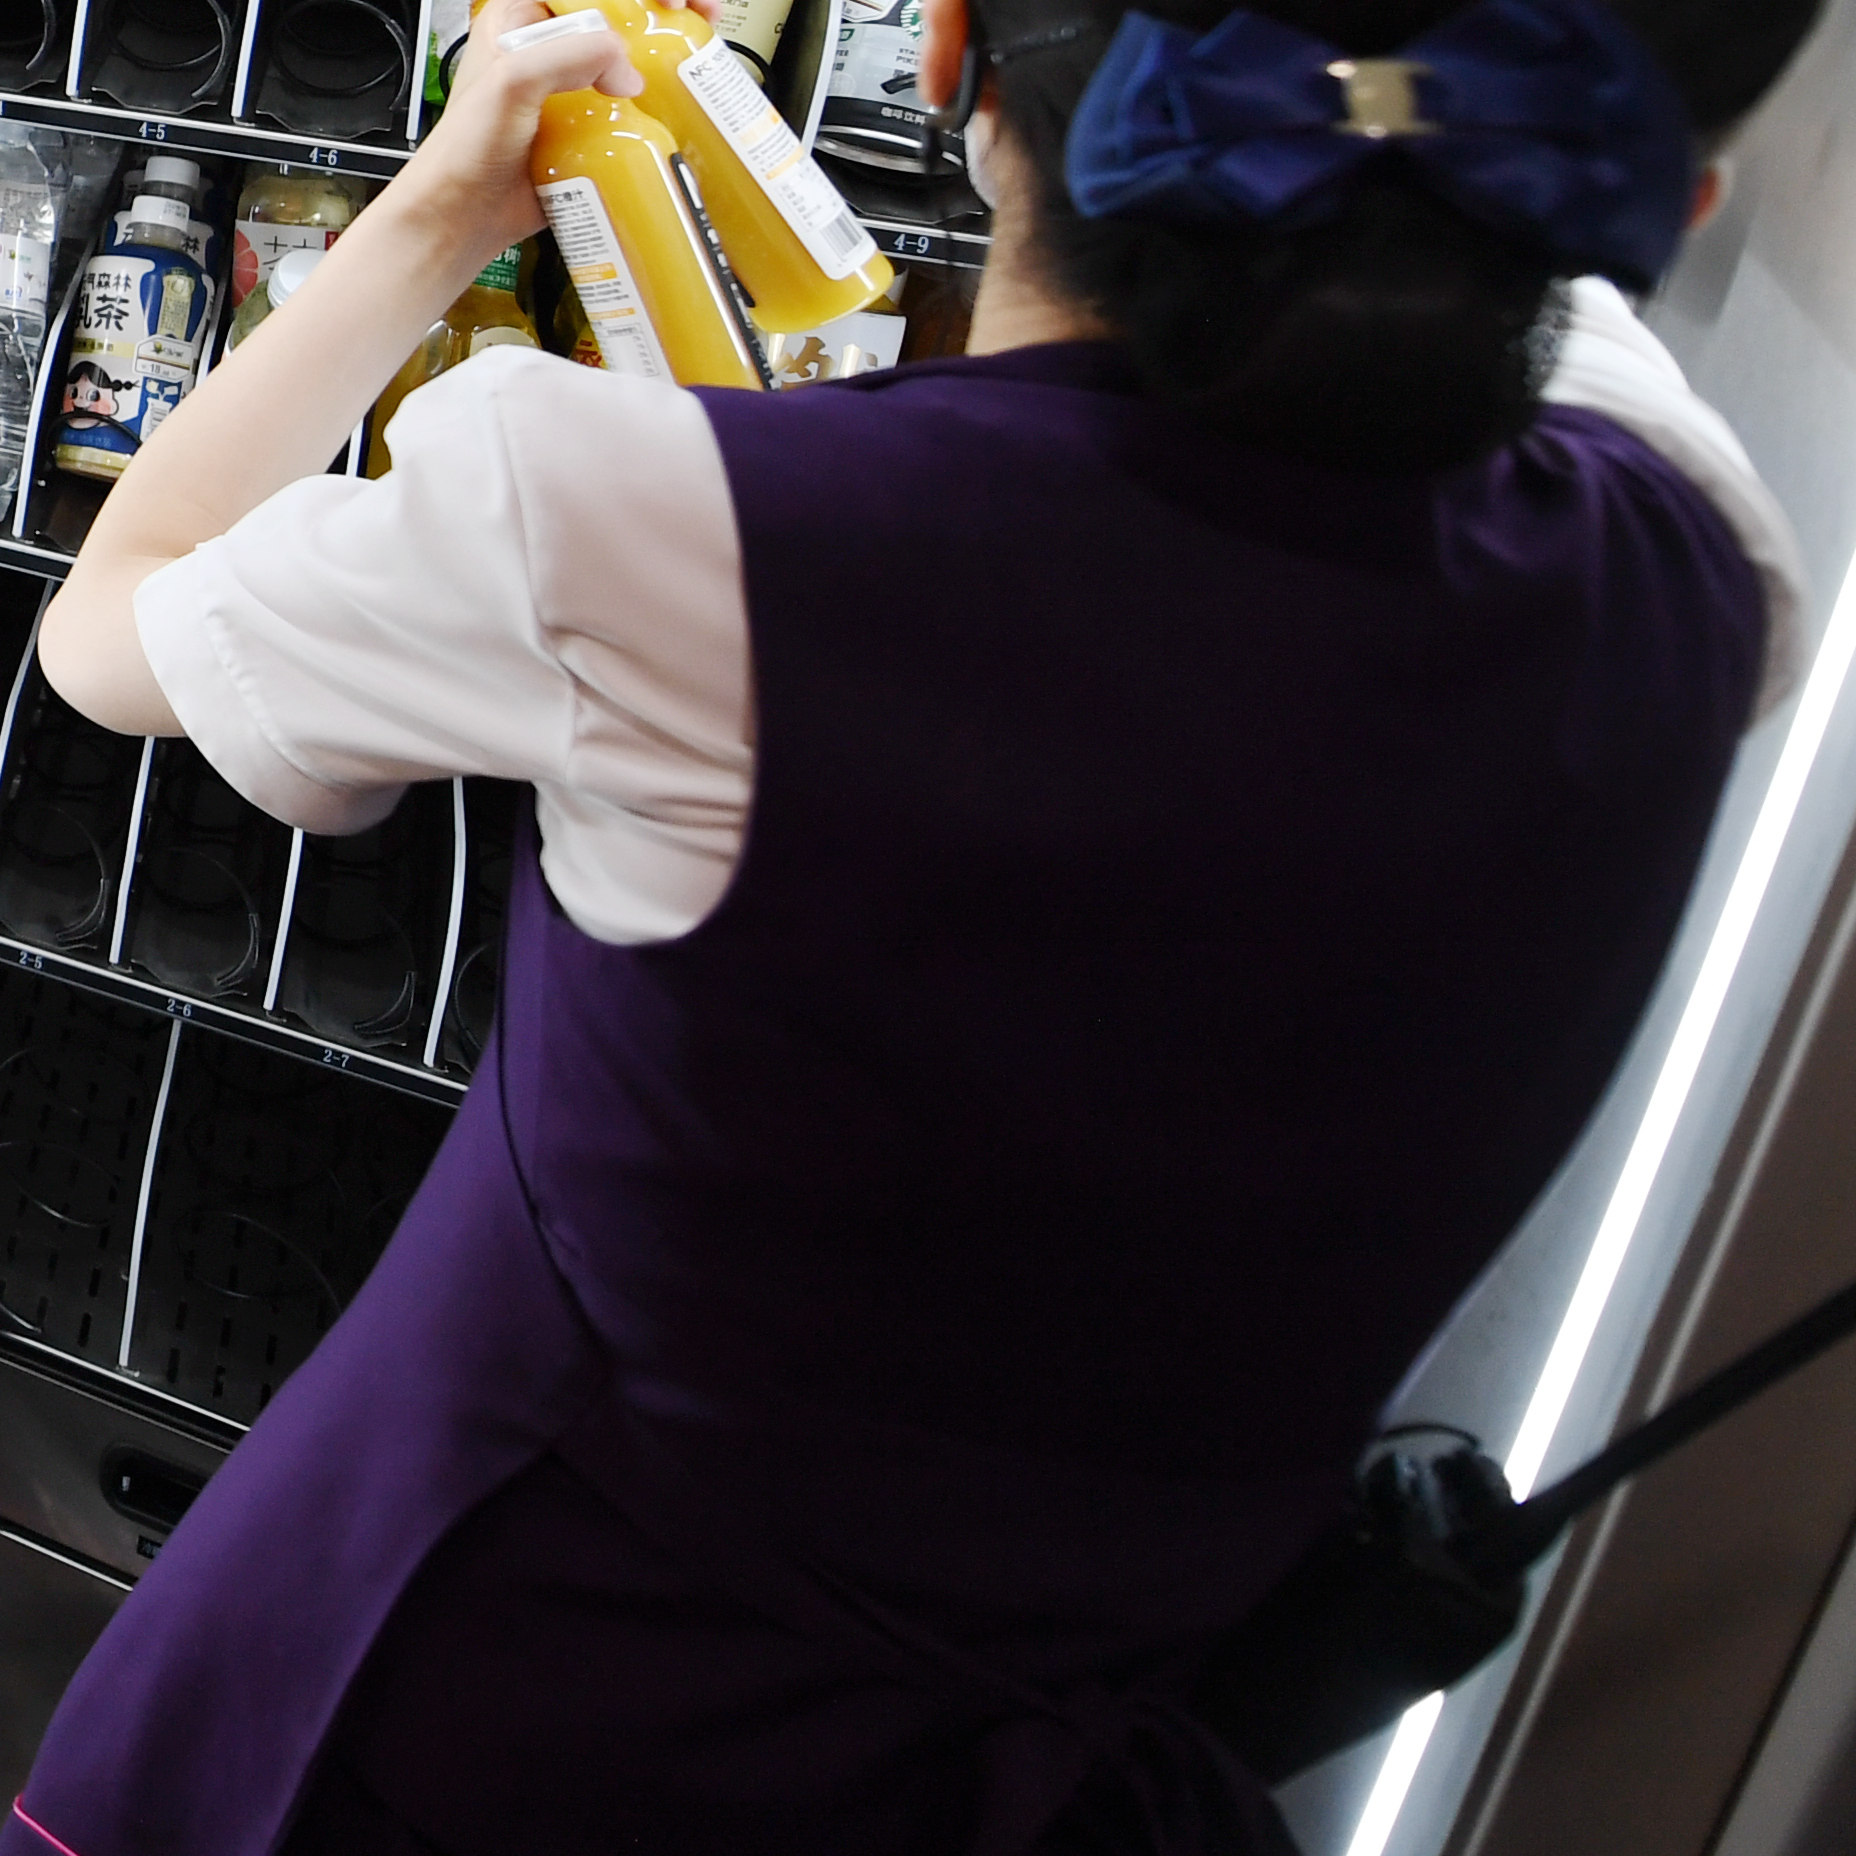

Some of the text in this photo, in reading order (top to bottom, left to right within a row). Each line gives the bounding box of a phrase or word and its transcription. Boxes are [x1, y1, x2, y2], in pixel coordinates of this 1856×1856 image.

[139, 122, 166, 141] 4-5
[309, 147, 338, 165] 4-6
[893, 234, 929, 255] 4-9
[19, 951, 43, 970] 2-5
[166, 998, 192, 1017] 2-6
[323, 1048, 350, 1068] 2-7
